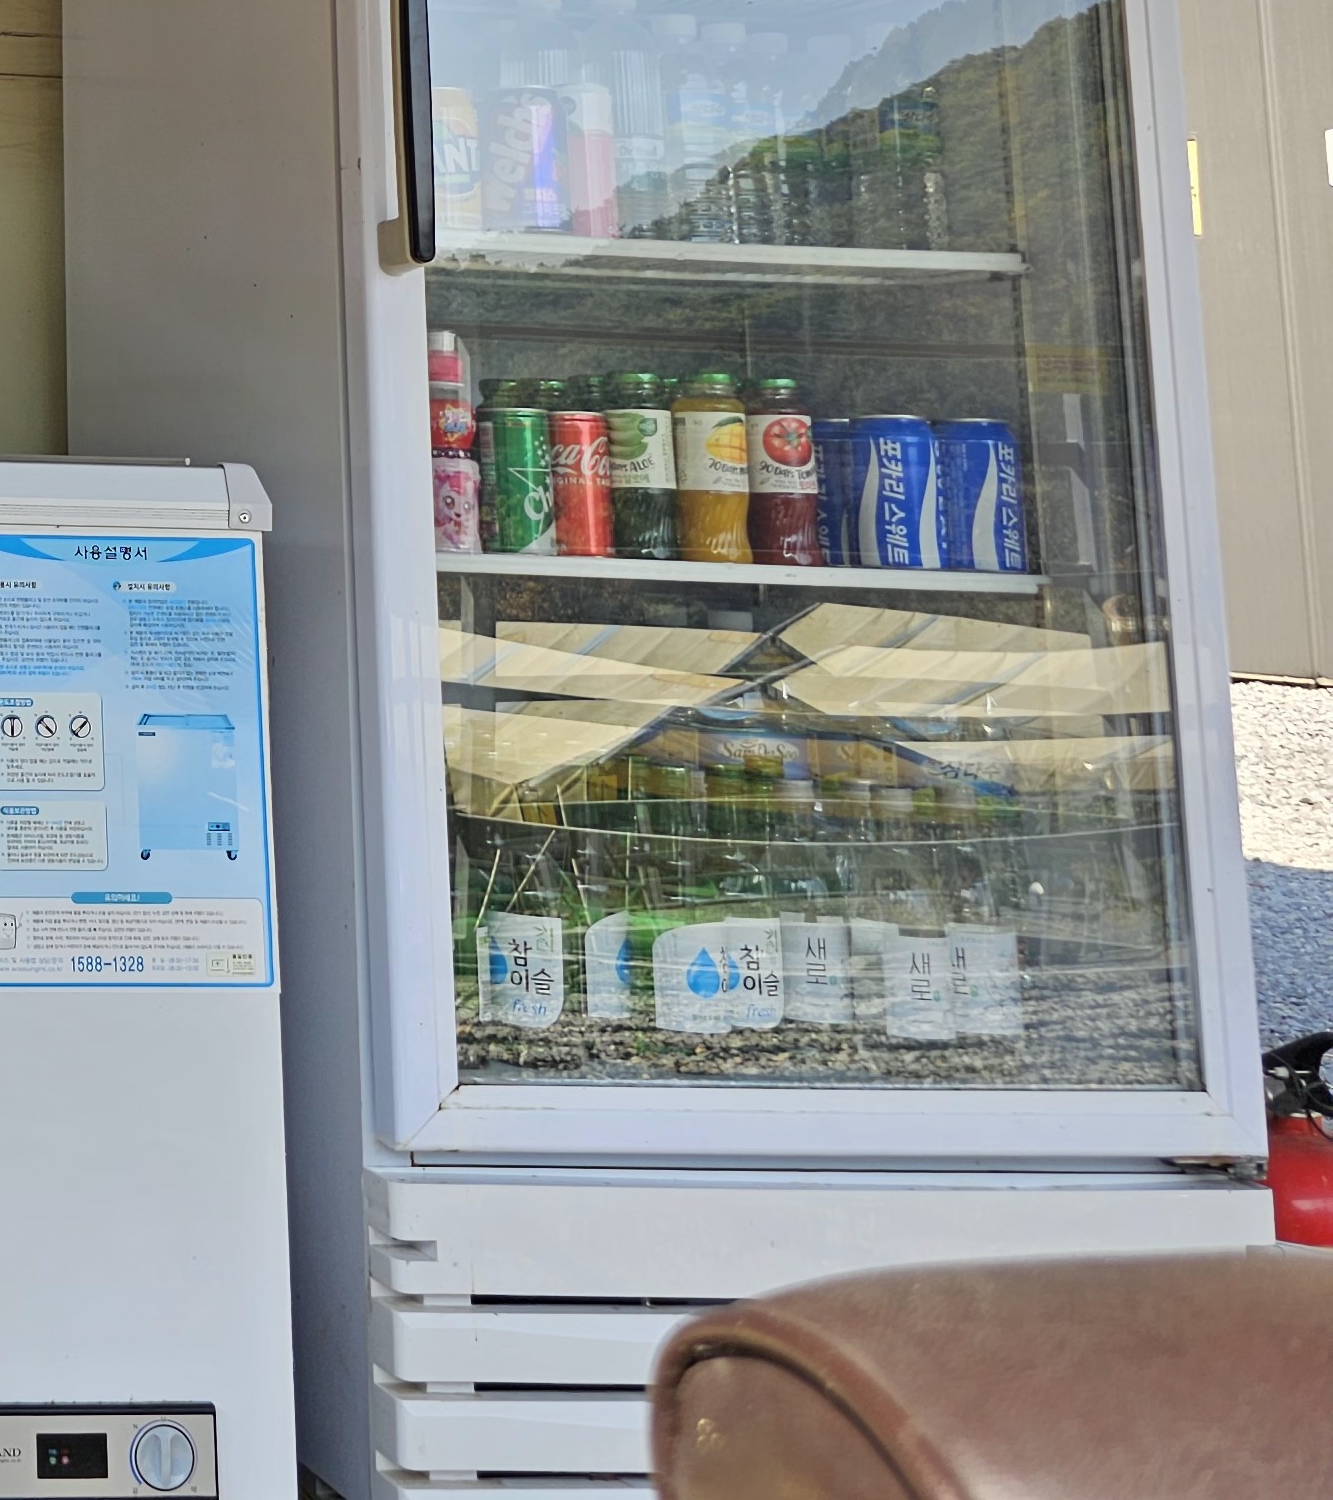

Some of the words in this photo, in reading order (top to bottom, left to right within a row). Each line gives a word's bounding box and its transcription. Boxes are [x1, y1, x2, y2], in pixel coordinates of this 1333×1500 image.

[879, 437, 905, 500] 포카리
[74, 544, 148, 562] 사용설명서
[885, 502, 910, 564] 스웨트
[71, 955, 144, 973] 1588-1328
